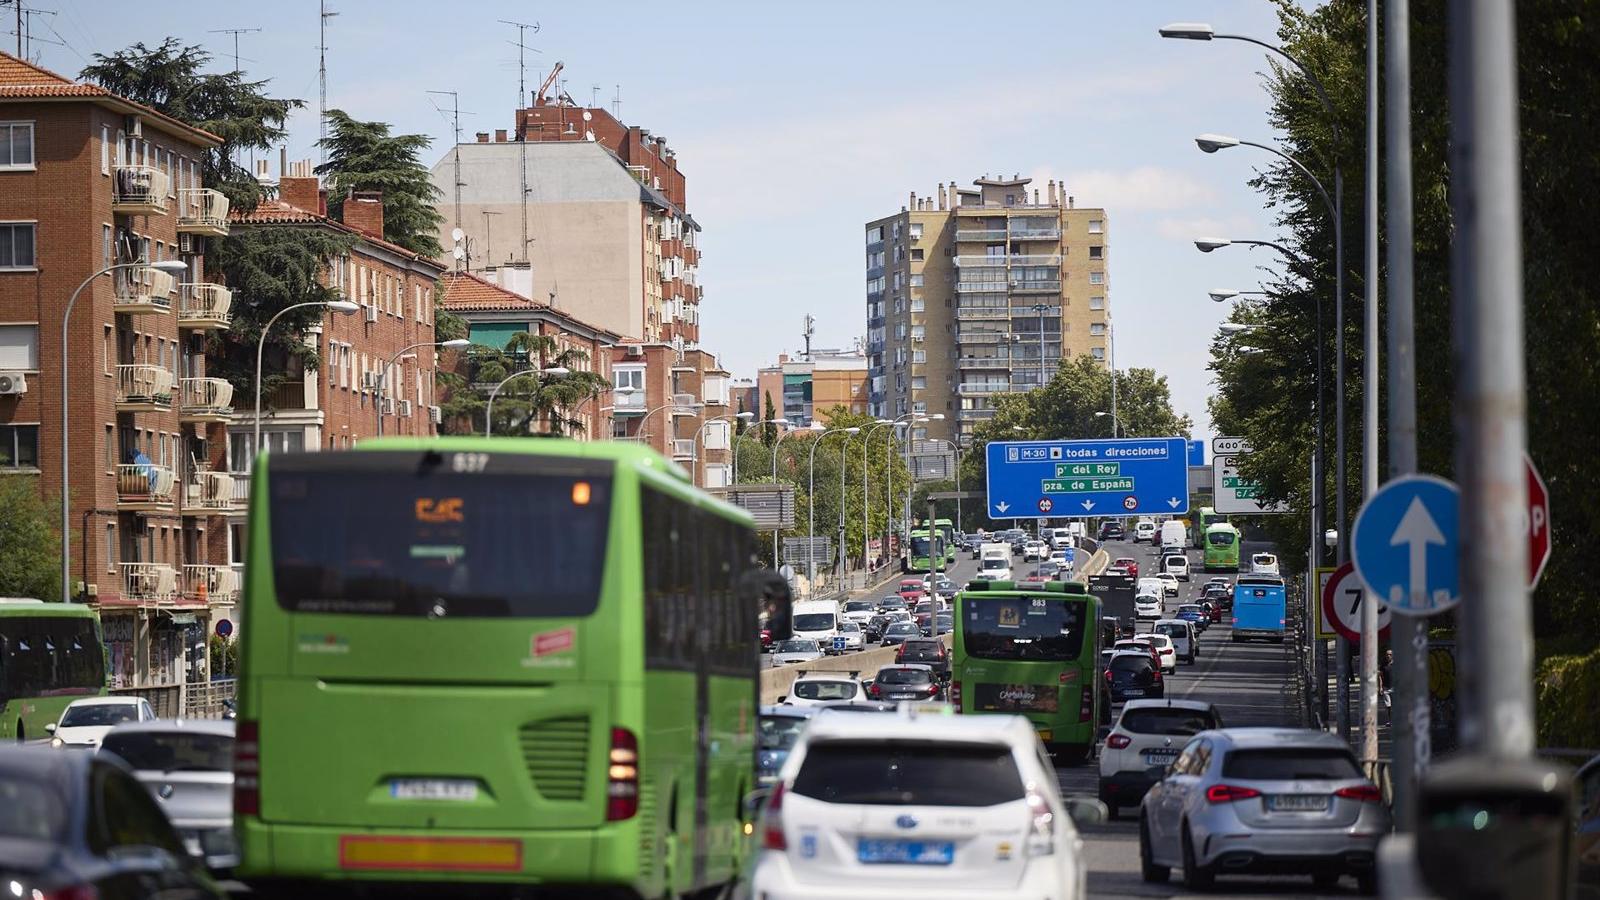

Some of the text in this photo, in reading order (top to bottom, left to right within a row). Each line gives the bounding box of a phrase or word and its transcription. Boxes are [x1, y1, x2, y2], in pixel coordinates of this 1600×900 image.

[1066, 448, 1098, 458] todas
[1105, 446, 1166, 457] direcciones
[1072, 464, 1090, 474] del
[1097, 464, 1117, 475] Rey
[1044, 479, 1132, 492] pza. de España
